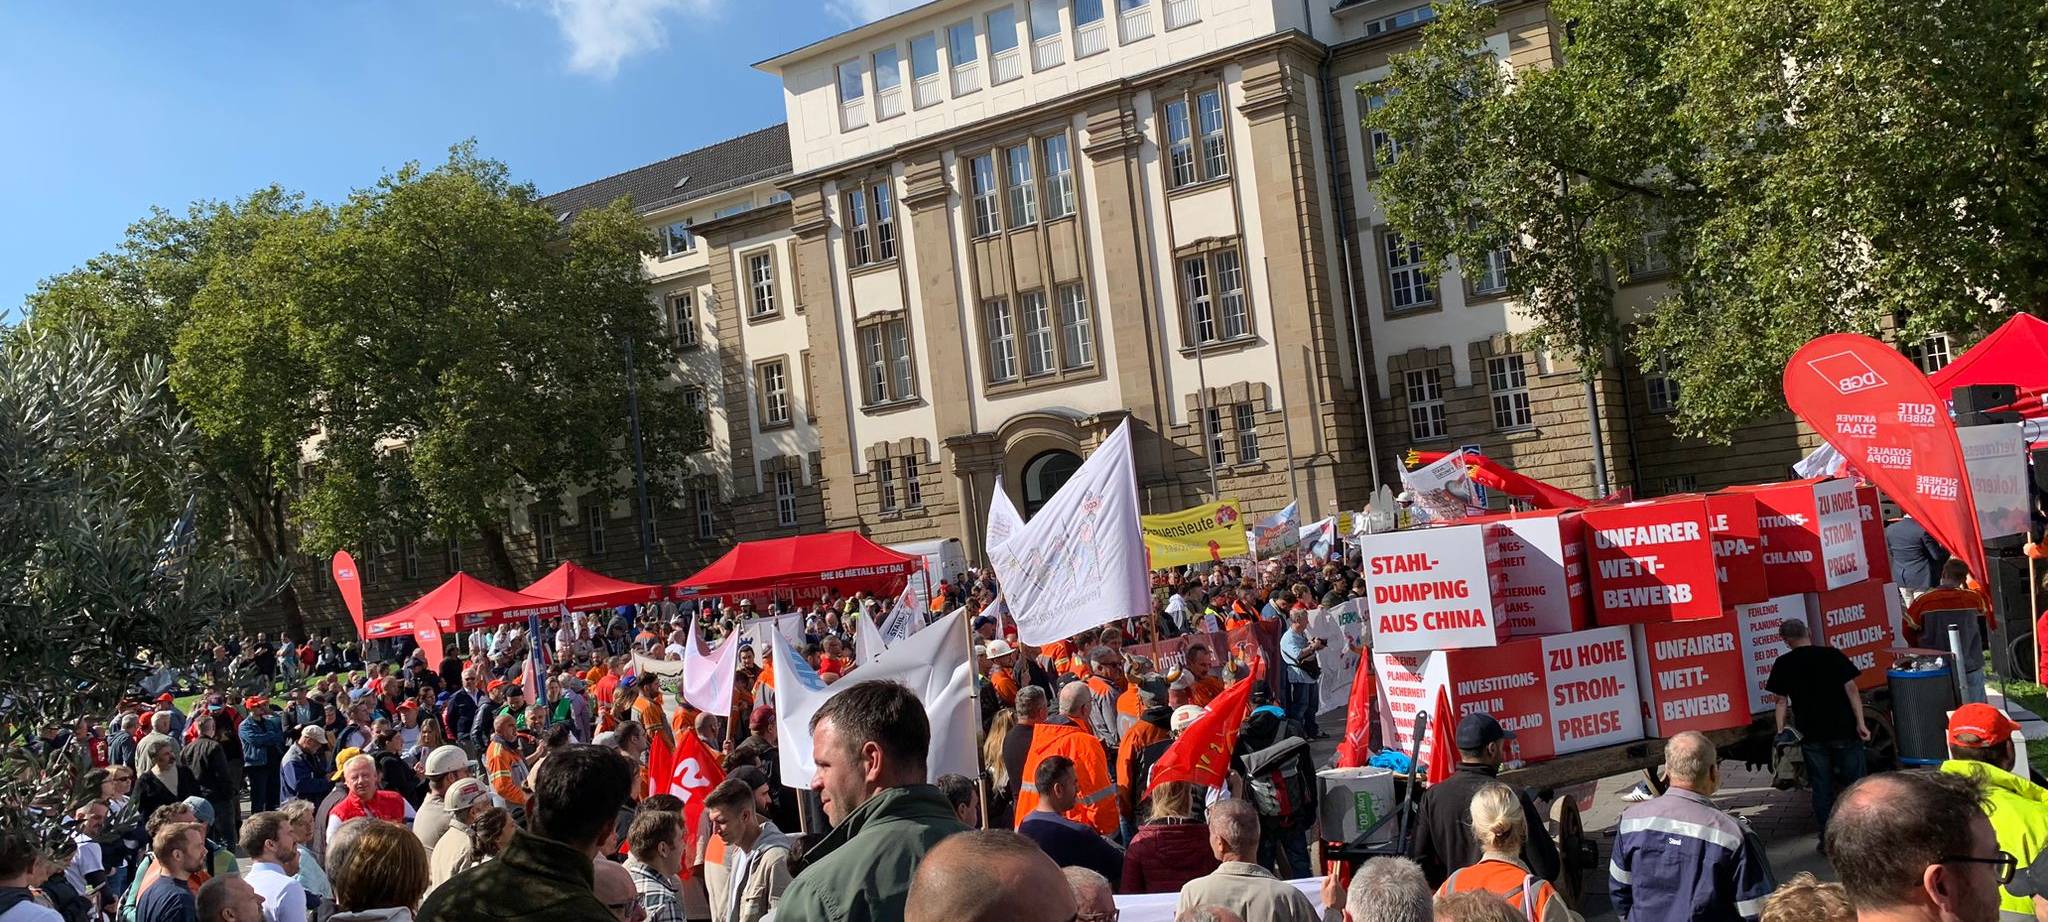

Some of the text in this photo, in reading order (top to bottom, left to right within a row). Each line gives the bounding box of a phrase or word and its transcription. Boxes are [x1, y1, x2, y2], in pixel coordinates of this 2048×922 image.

[1818, 496, 1831, 516] ZU
[1832, 490, 1855, 513] HOHE
[1758, 513, 1809, 528] TITIONS-
[1594, 521, 1701, 549] UNFAIRER
[1823, 522, 1857, 547] STROM-
[1371, 553, 1439, 575] STAHL-
[1598, 555, 1664, 579] WETT-
[1762, 550, 1813, 565] CHLAND
[1828, 552, 1858, 577] PREISE
[821, 564, 904, 580] DIE IG METALL IST DA!
[1374, 580, 1469, 604] DUMPING
[1603, 583, 1693, 609] BEWERB
[1379, 613, 1418, 633] AUS
[1423, 609, 1486, 630] CHINA
[1748, 604, 1779, 617] FEHLENDE
[1826, 603, 1866, 627] STARRE
[1750, 618, 1784, 632] PLANUNGS
[1654, 632, 1735, 660] UNFAIRER
[1830, 625, 1886, 650] SCHULDEN-
[1385, 656, 1417, 666] FEHLENDE
[1548, 639, 1627, 672] ZU HOHE
[1754, 648, 1778, 661] BEI DER
[1387, 671, 1424, 682] PLANUNGS-
[1458, 672, 1539, 696] INVESTITIONS-
[1658, 666, 1709, 690] WETT-
[1389, 686, 1426, 698] SICHERHEIT
[1554, 675, 1625, 706] STROM-
[1390, 702, 1416, 713] BEI DER
[1460, 698, 1504, 718] STAU IN
[1662, 693, 1730, 720] BEWERB
[1499, 713, 1542, 731] CHLAND
[1558, 710, 1621, 741] PREISE
